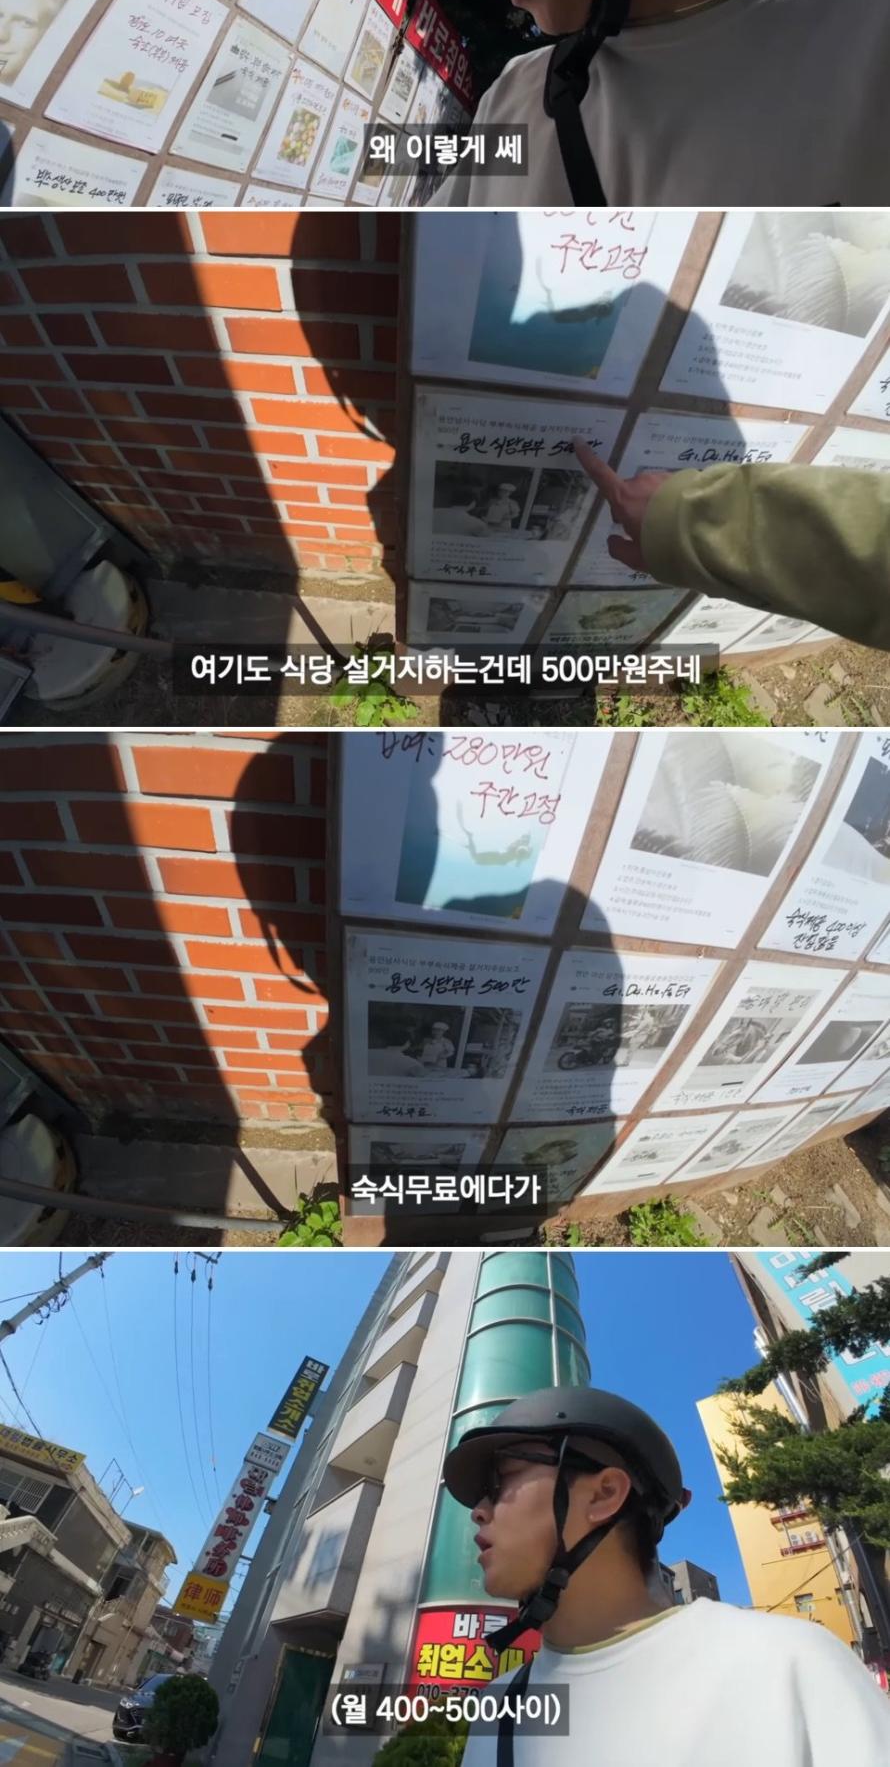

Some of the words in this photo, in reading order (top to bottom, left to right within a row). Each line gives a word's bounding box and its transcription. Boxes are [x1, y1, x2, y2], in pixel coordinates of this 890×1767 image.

[551, 234, 648, 280] 주간고정
[443, 735, 549, 780] 280만원
[470, 782, 562, 825] 주간고정
[275, 1360, 326, 1431] 바로취업소개소
[183, 1582, 223, 1607] 律师
